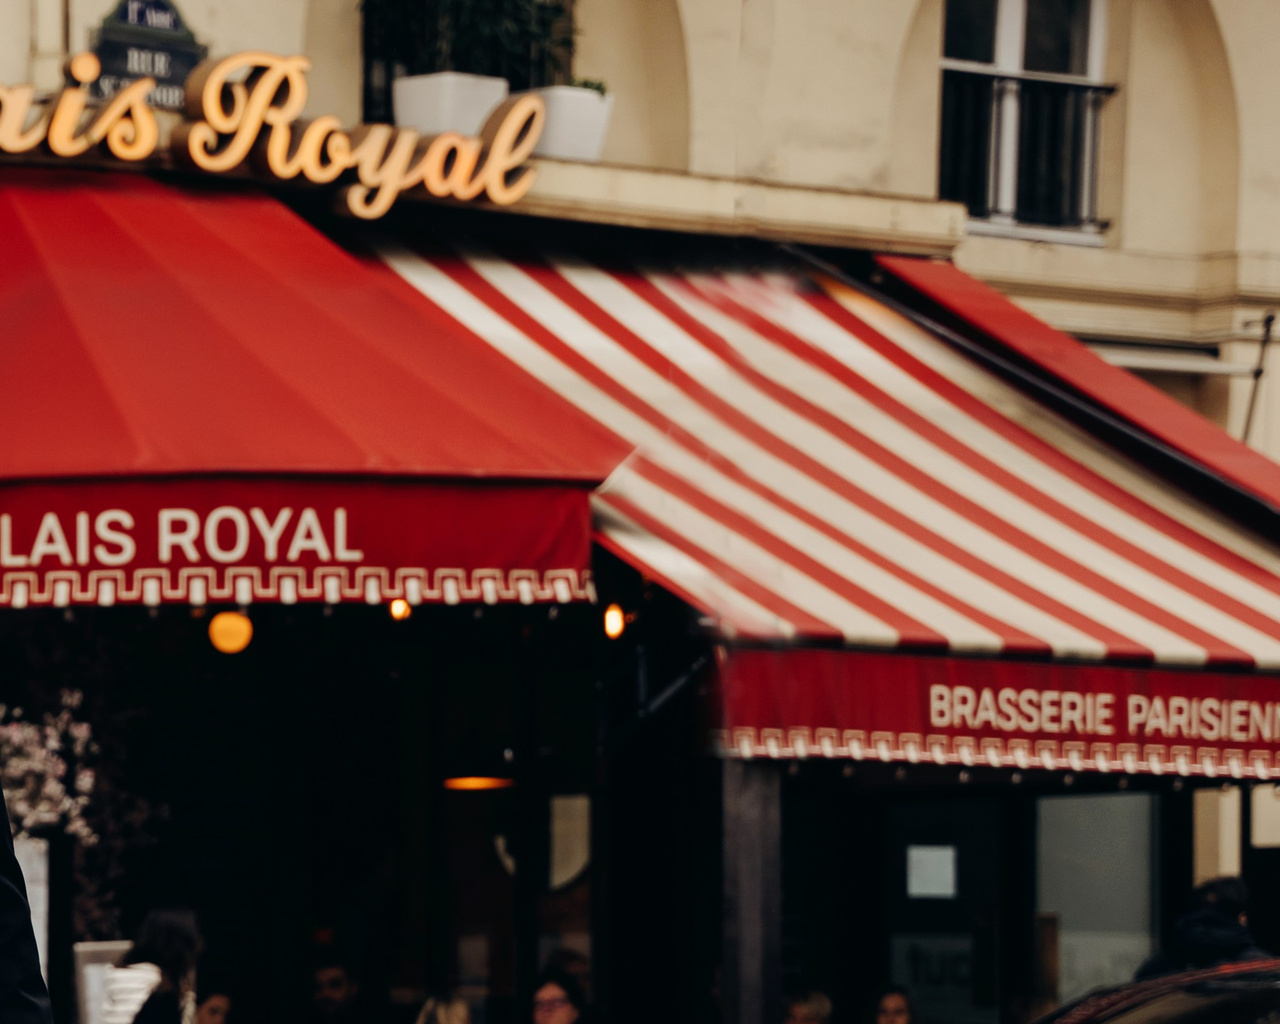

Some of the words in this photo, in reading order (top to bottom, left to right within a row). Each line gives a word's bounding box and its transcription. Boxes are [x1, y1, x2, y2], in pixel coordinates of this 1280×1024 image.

[188, 50, 546, 220] Royal
[158, 506, 364, 563] ROYAL
[929, 684, 1115, 735] BRASSERIE
[1127, 694, 1280, 742] PARISIEN
